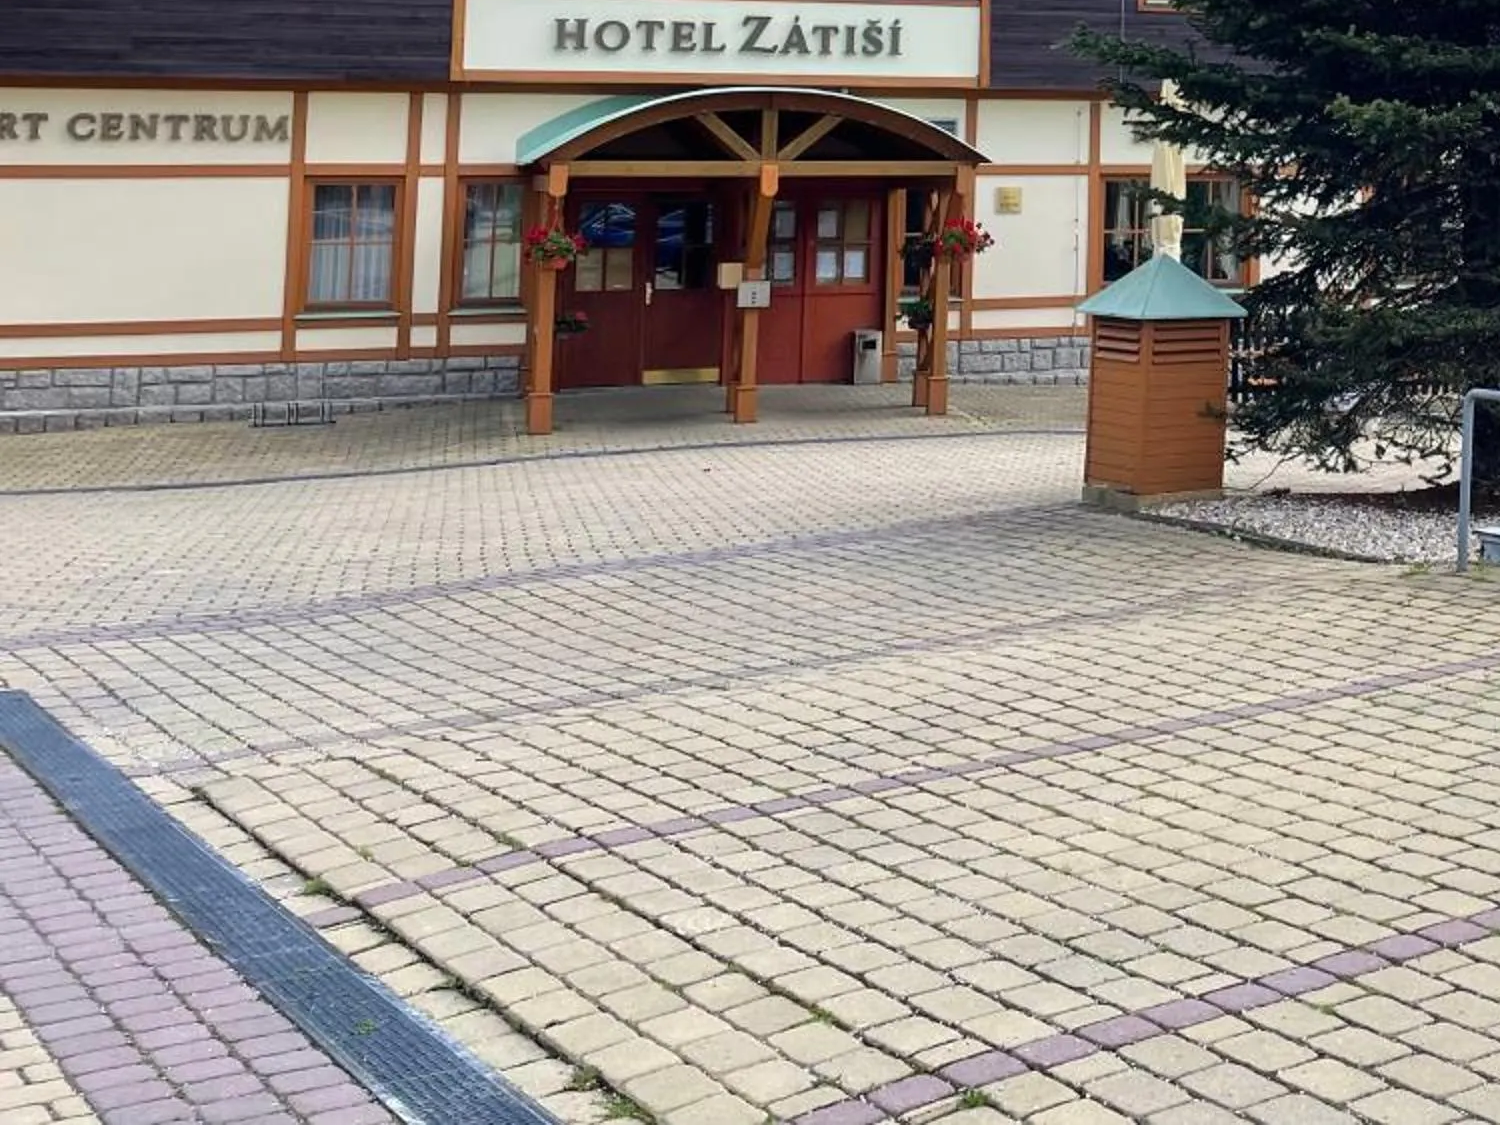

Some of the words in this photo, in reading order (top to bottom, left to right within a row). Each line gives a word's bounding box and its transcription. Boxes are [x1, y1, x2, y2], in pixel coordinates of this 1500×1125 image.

[553, 18, 727, 53] HOTEL
[738, 15, 904, 56] ZÁTIŠÍ
[66, 112, 289, 142] CENTRUM
